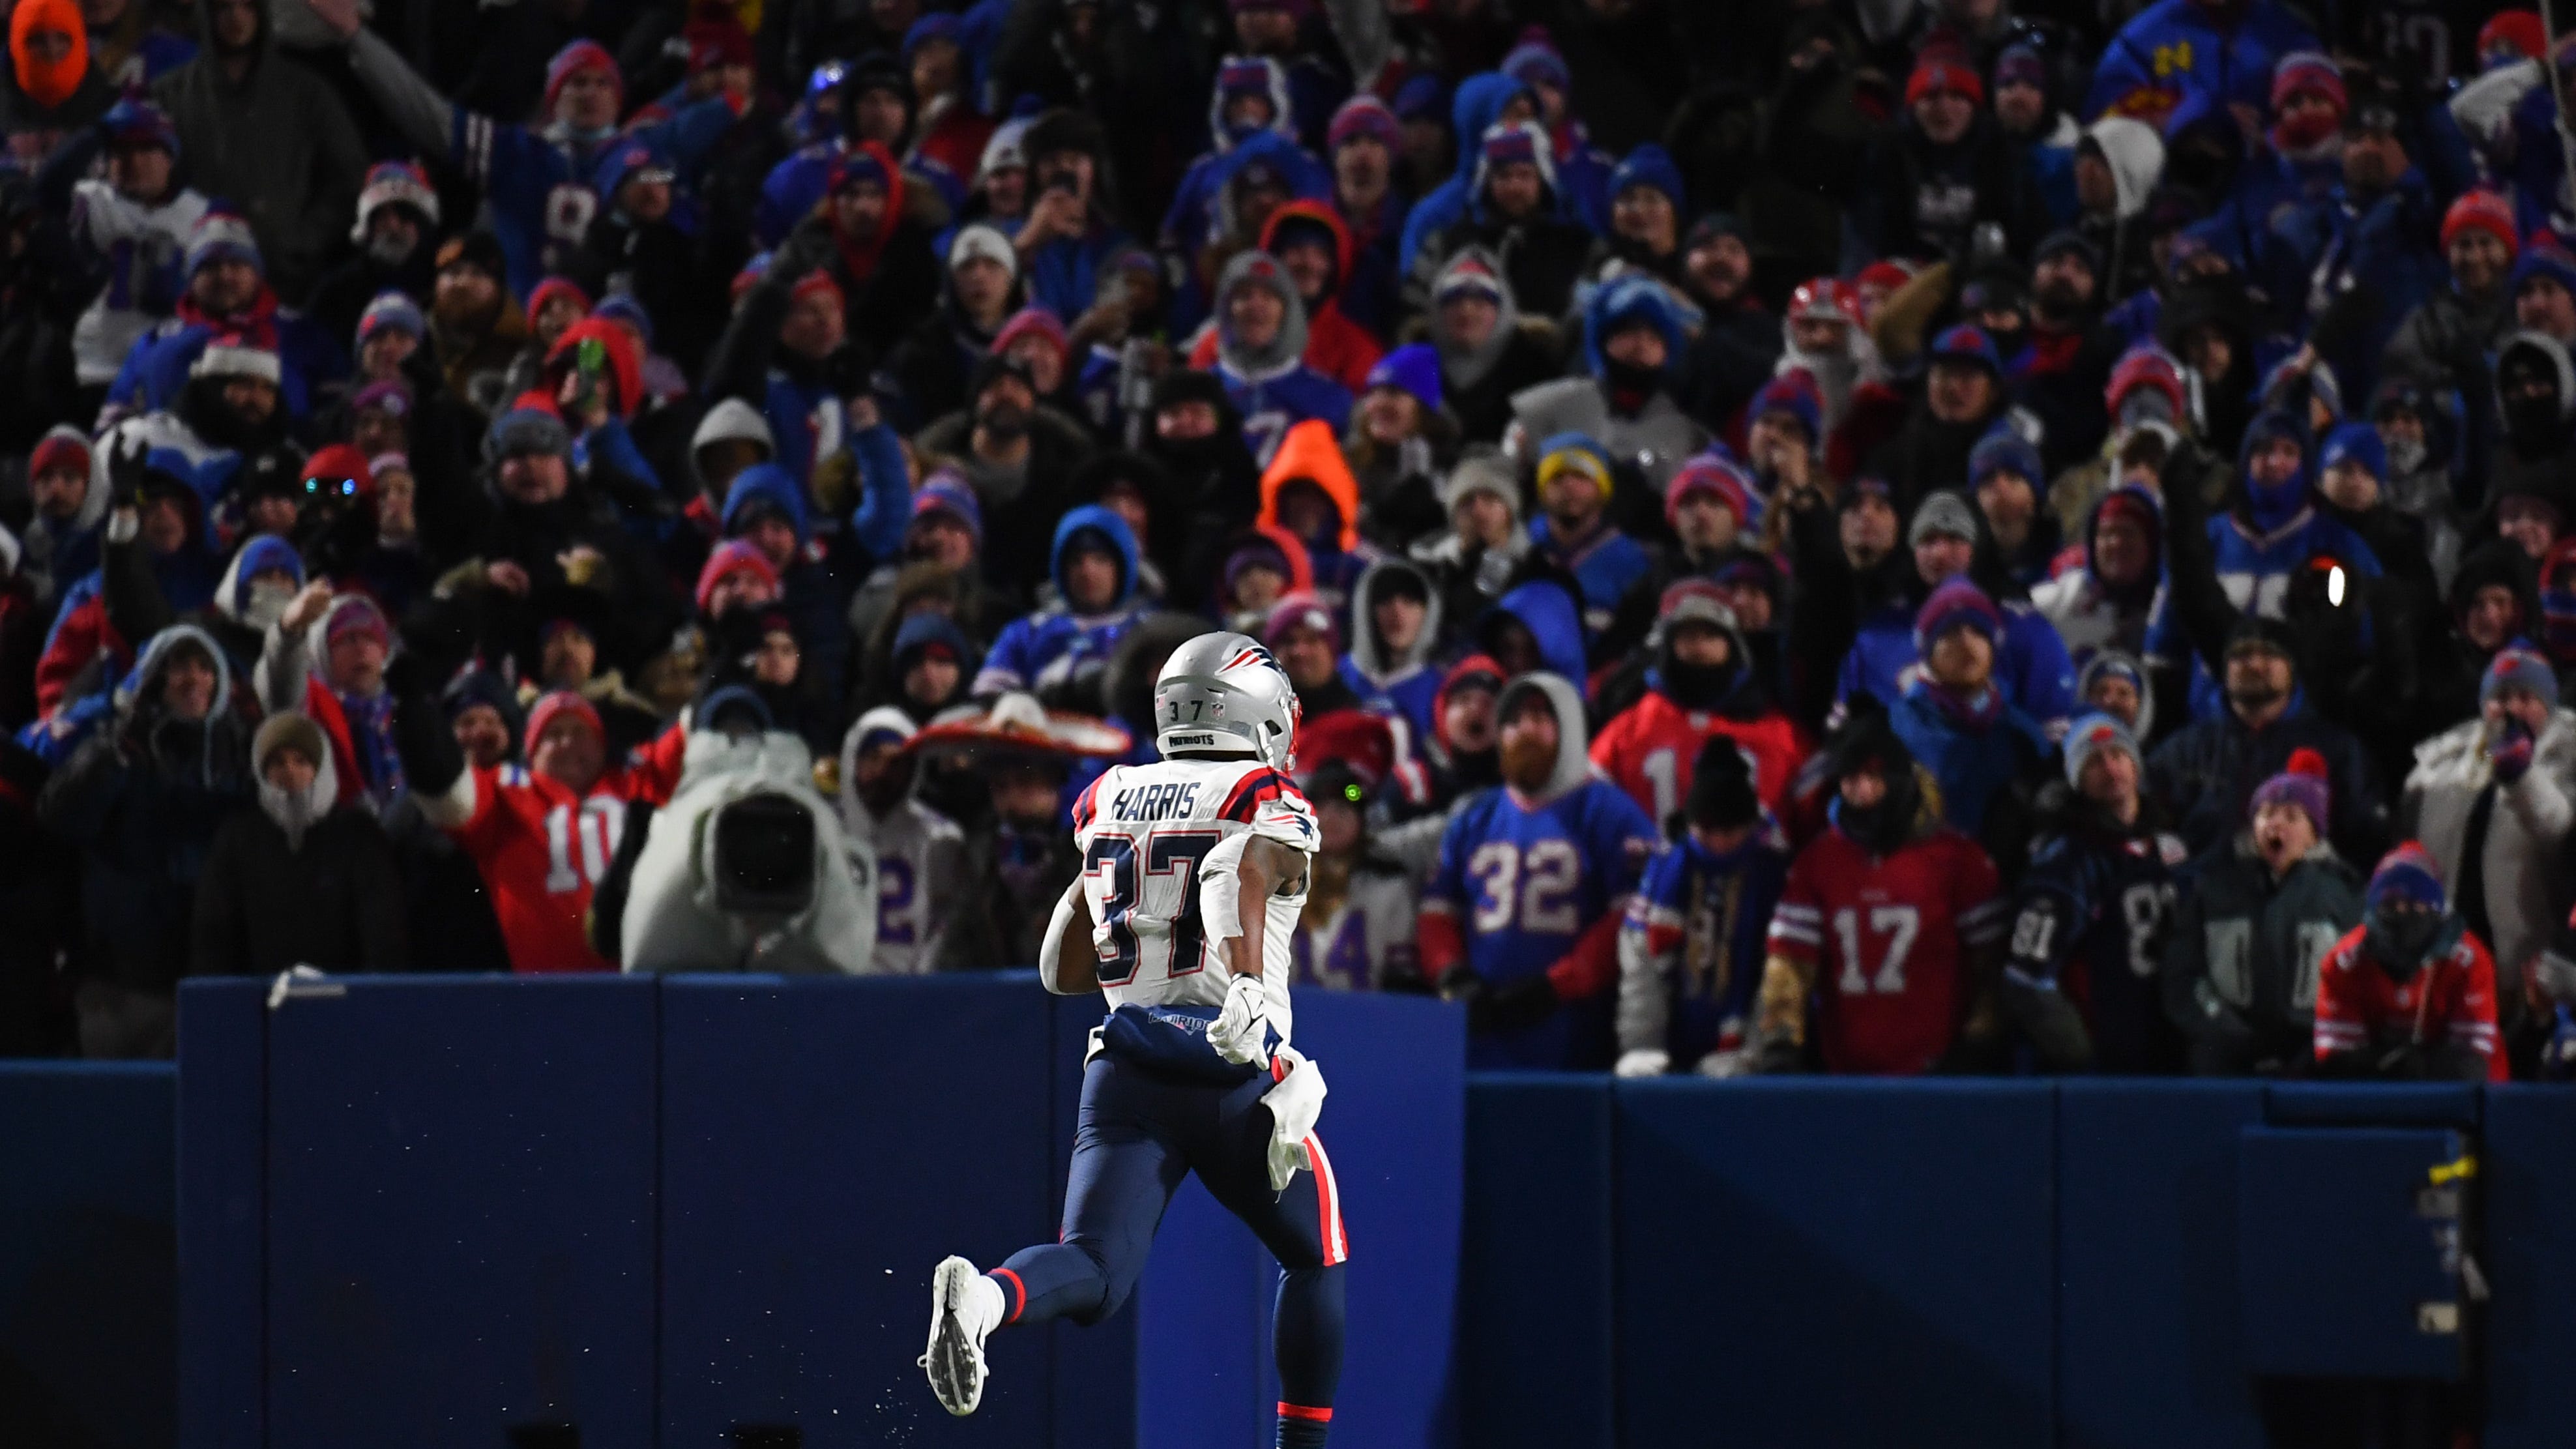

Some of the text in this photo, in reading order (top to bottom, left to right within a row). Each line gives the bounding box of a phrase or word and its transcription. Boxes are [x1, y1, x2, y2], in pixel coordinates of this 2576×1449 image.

[1169, 734, 1214, 748] PATRIOTS
[544, 793, 628, 894] 10
[1112, 782, 1201, 821] HARRIS
[1082, 829, 1222, 988] 37
[1469, 838, 1579, 933] 32
[1832, 904, 1920, 993] 17
